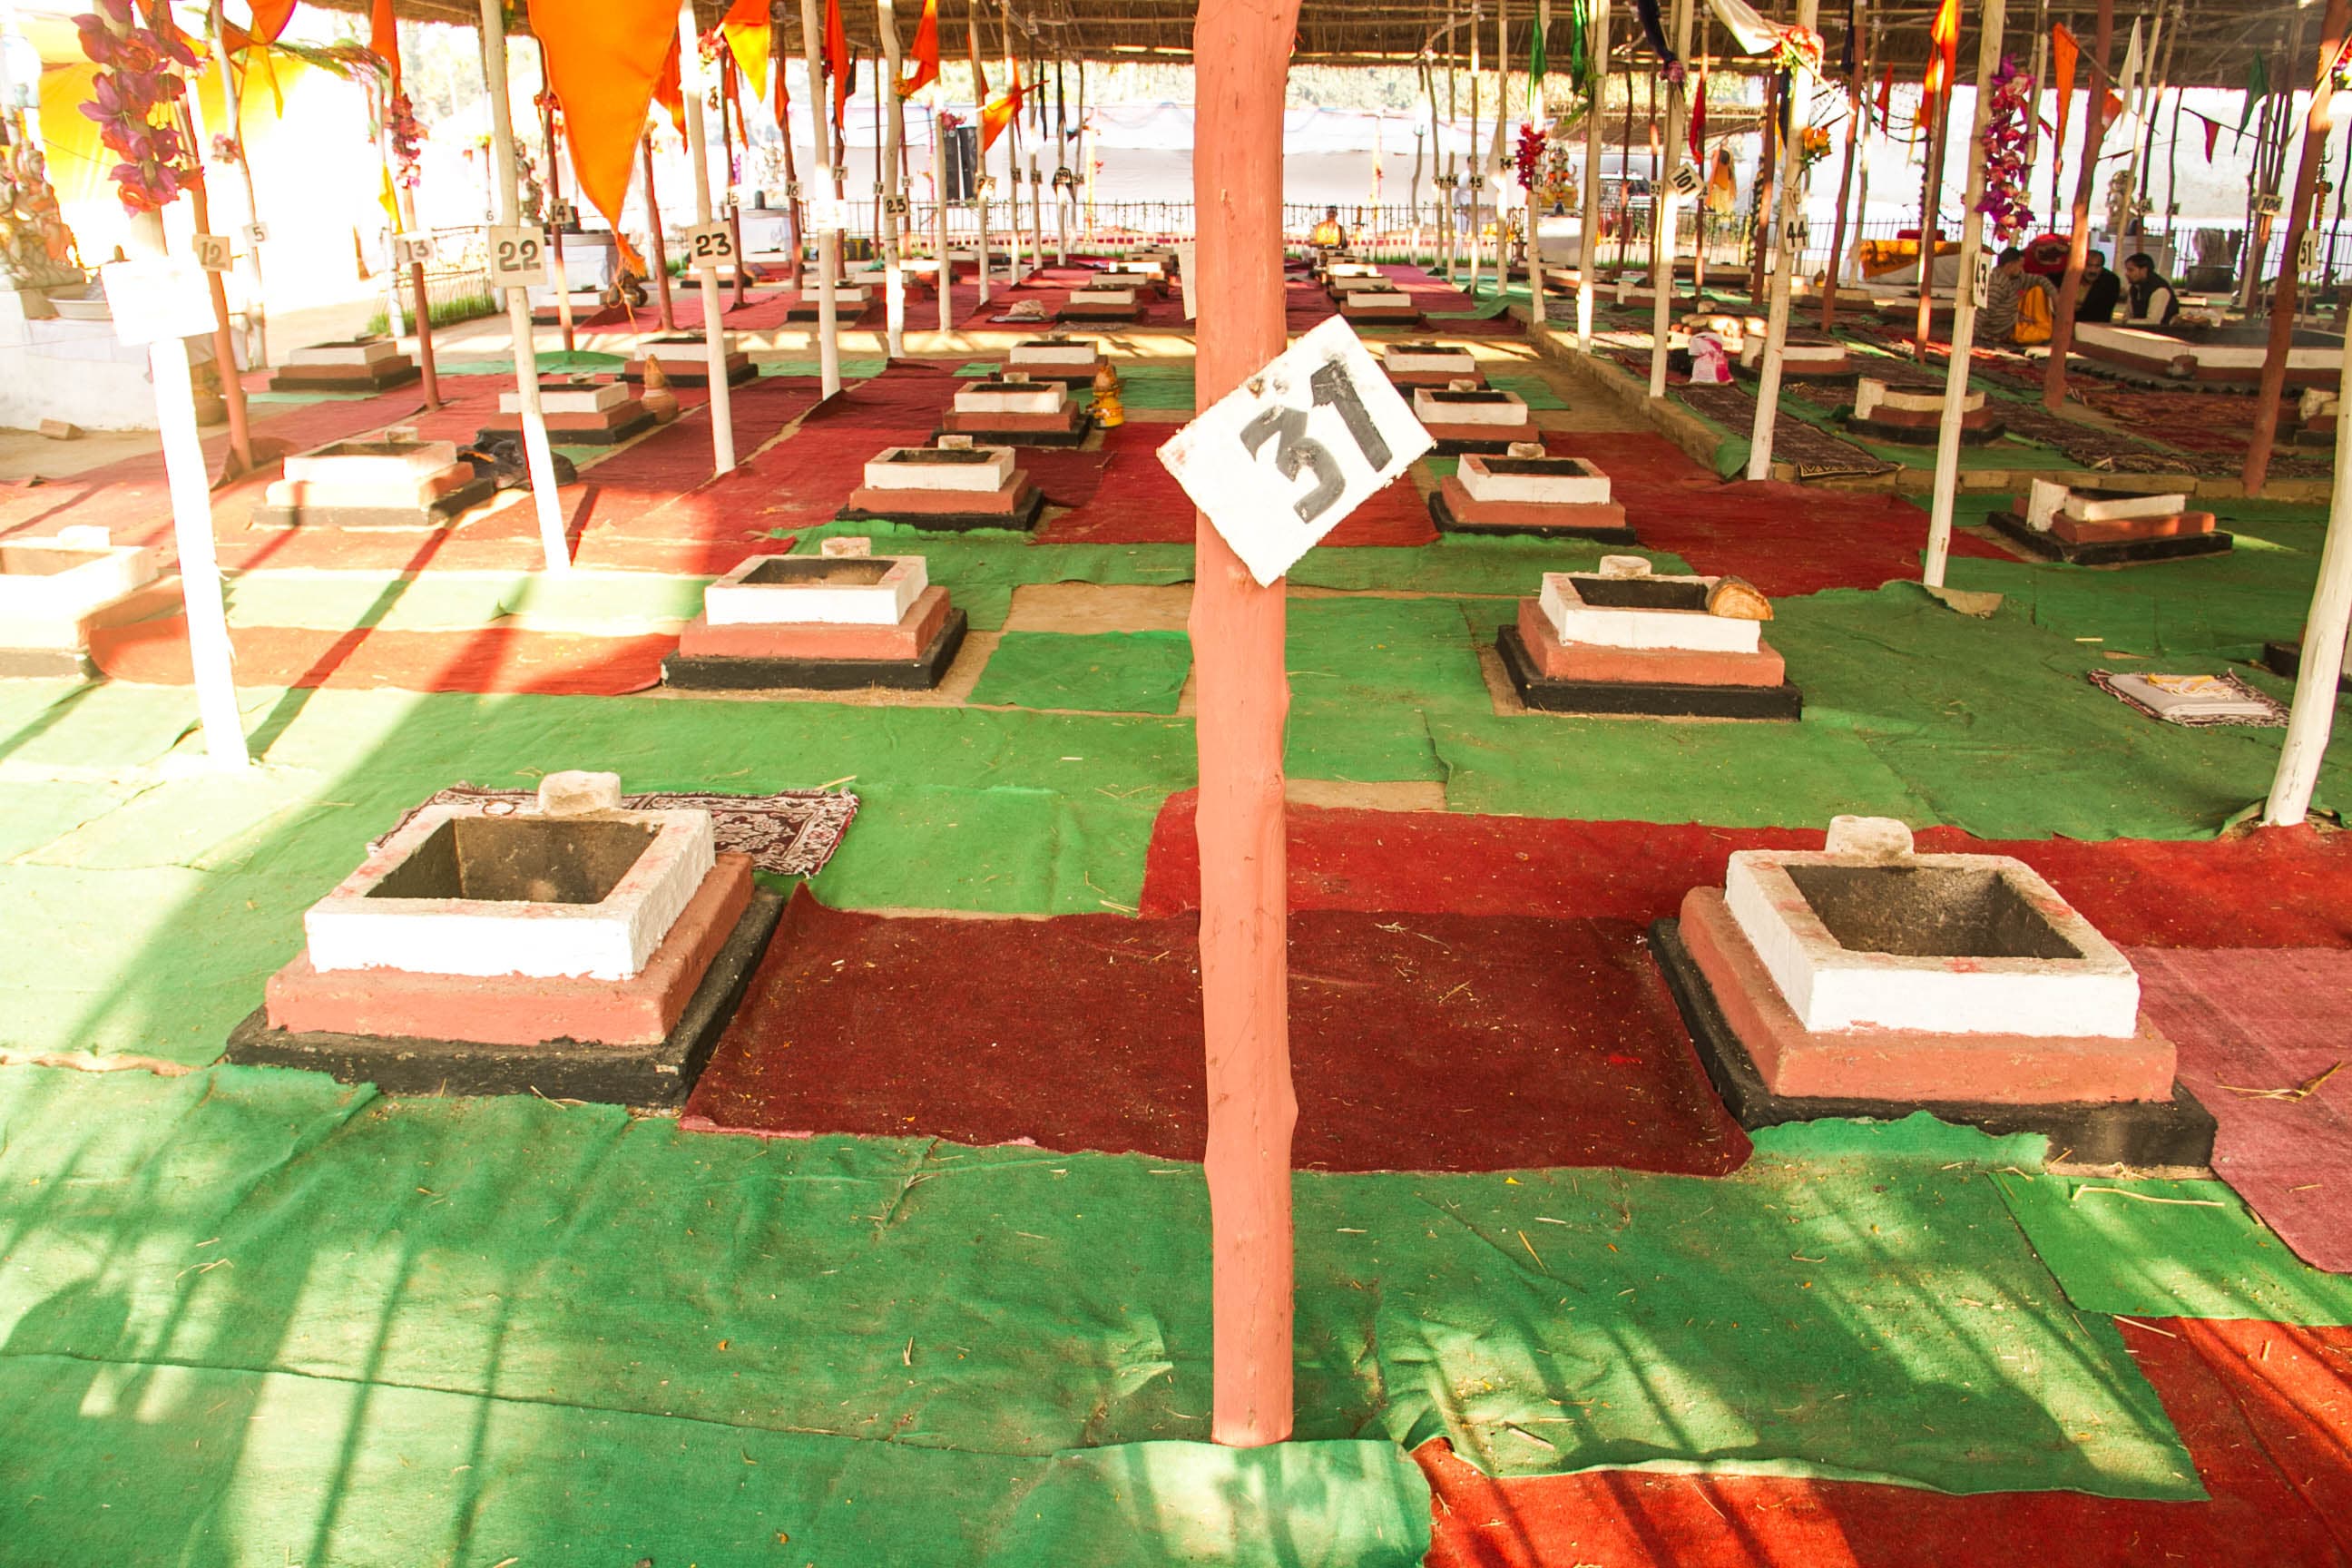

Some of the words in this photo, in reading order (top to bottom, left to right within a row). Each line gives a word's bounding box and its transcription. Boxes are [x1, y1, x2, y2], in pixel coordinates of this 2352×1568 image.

[787, 183, 799, 197] 16
[1470, 176, 1483, 188] 45
[1672, 168, 1697, 196] 101
[485, 210, 495, 221] 6
[552, 205, 566, 221] 14
[886, 198, 906, 213] 25
[252, 225, 265, 242] 5
[1786, 220, 1808, 248] 44
[201, 240, 227, 268] 12
[404, 240, 429, 261] 13
[695, 232, 732, 257] 23
[498, 240, 542, 271] 22
[1240, 359, 1394, 524] 31
